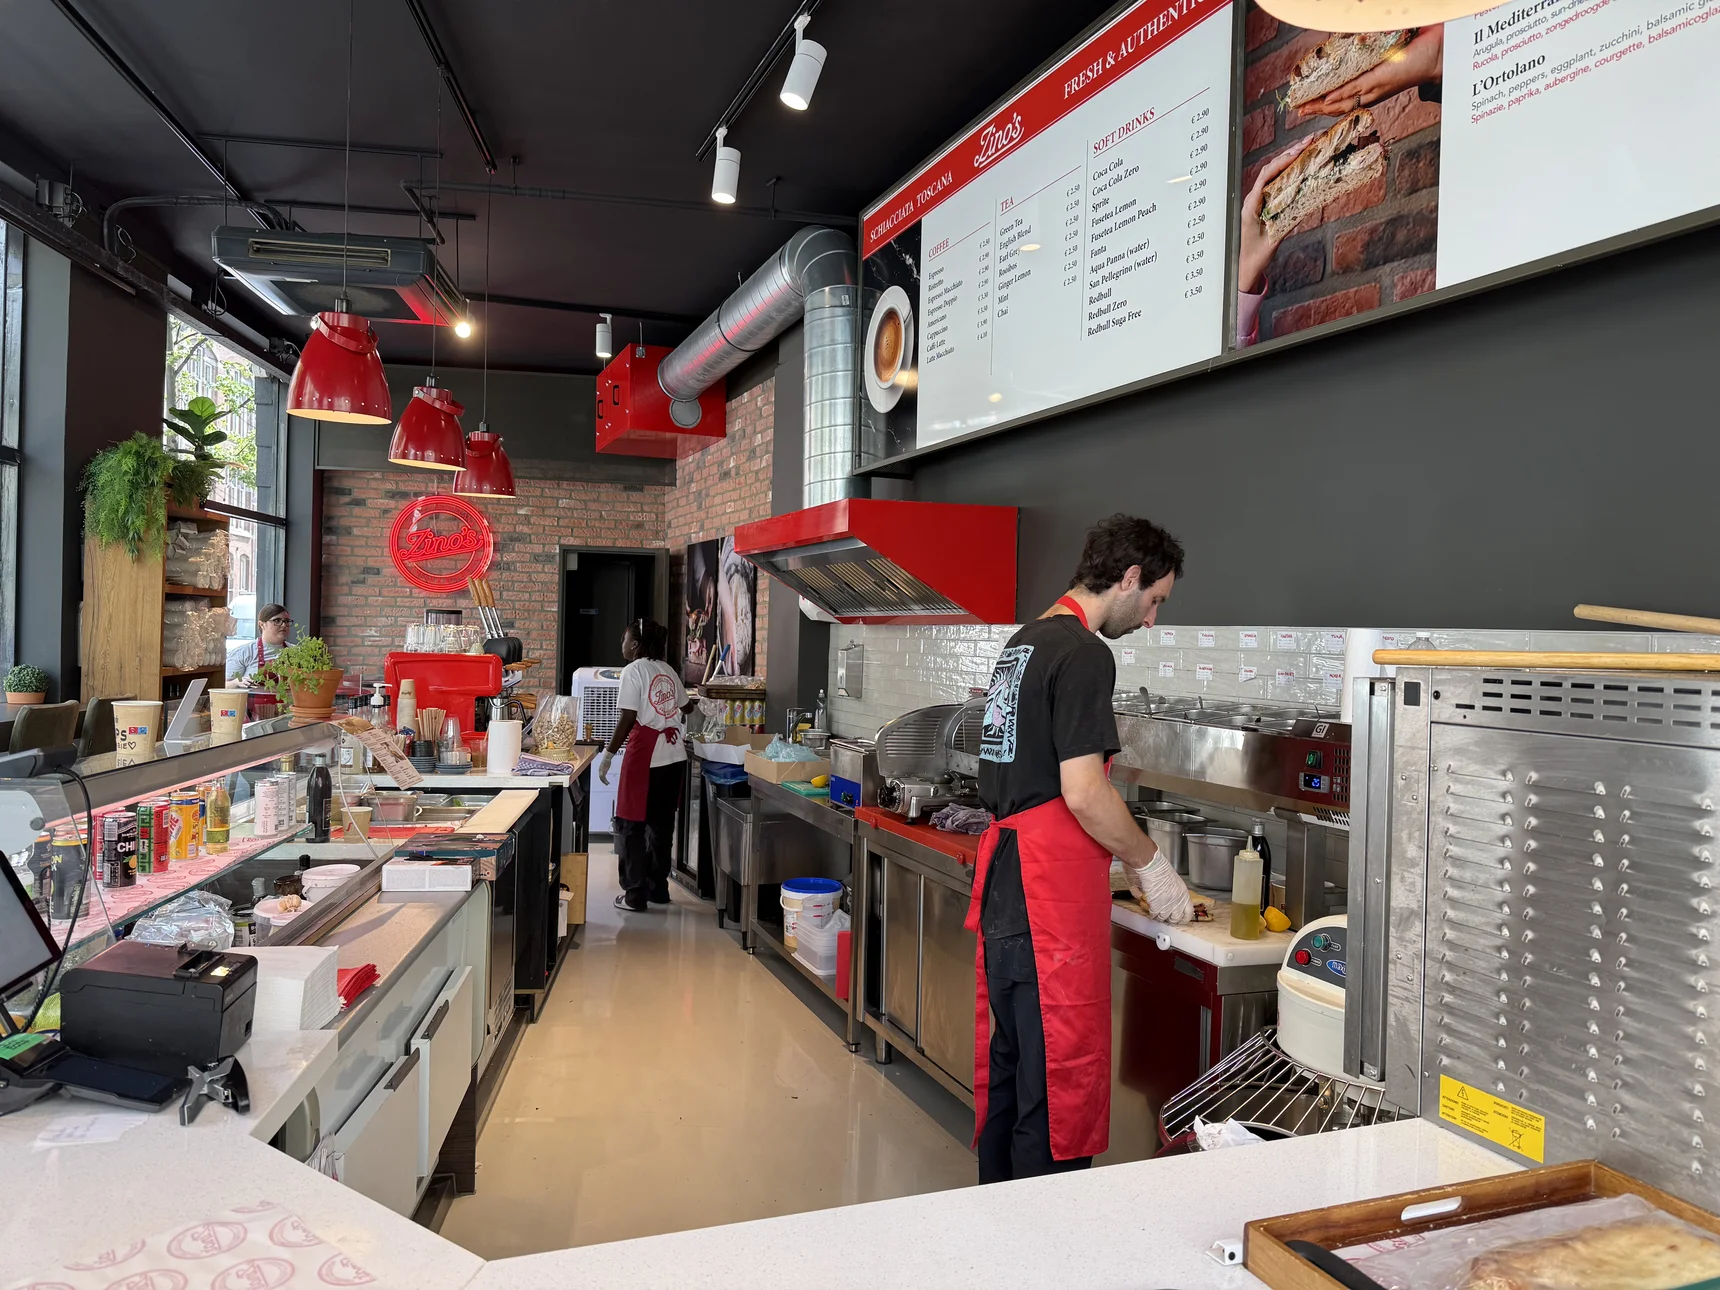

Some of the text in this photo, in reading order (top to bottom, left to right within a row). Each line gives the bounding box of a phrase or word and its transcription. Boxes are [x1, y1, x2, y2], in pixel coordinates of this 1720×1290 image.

[1473, 36, 1504, 58] Arugula,
[1506, 17, 1548, 44] prosciutto,
[1474, 29, 1483, 45] Il
[1471, 2, 1695, 111] Spinach, peppers, eggplant, zucchini, balsamic
[1472, 55, 1499, 70] Rucola,
[1501, 32, 1543, 59] prosciutto,
[1064, 58, 1103, 99] FRESH
[1106, 51, 1115, 68] &
[1471, 104, 1505, 124] Spinazie,
[1508, 88, 1541, 110] paprika,
[1544, 64, 1591, 90] aubergine,
[1595, 41, 1645, 68] courgette,
[1472, 55, 1545, 97] L'Ortolano
[1197, 108, 1209, 120] 2.90
[1093, 107, 1155, 154] SOFT DRINKS
[1196, 126, 1208, 138] 2.90
[974, 113, 1024, 168] Zino's
[1195, 144, 1208, 156] 2.90
[1093, 158, 1123, 181] Coca Cola
[1195, 161, 1207, 173] 2.90
[1092, 165, 1140, 196] Coca Cola Zero
[1194, 179, 1206, 190] 2.90
[870, 171, 953, 242] SCHIACCIATA TOSCANA
[1001, 196, 1014, 212] TEA
[1092, 197, 1110, 212] Sprite
[1193, 196, 1206, 208] 2.90
[1092, 198, 1137, 227] Fusetea Lemon
[1193, 214, 1205, 226] 2.50
[1000, 224, 1013, 236] Green
[1091, 203, 1157, 242] Fusetea Lemon Peach
[1000, 225, 1031, 250] English Blend
[1192, 232, 1204, 244] 2.50
[929, 238, 949, 258] COFFEE
[1090, 238, 1150, 275] Aqua Panna (water)
[1091, 245, 1106, 258] Fanta
[1191, 250, 1204, 261] 3.50
[1000, 252, 1008, 263] Earl
[999, 263, 1017, 277] Rooibos
[1089, 251, 1157, 289] San Pellegrino (water)
[1190, 268, 1203, 279] 3.50
[998, 270, 1031, 290] Ginger Lemon
[998, 294, 1008, 304] Mint
[1089, 288, 1112, 305] Redbull
[1190, 286, 1202, 297] 3.50
[997, 306, 1008, 317] Chai
[1088, 300, 1127, 321] Redbull Zero
[1088, 310, 1142, 336] Redbull Suga Free
[399, 527, 484, 561] Zino's
